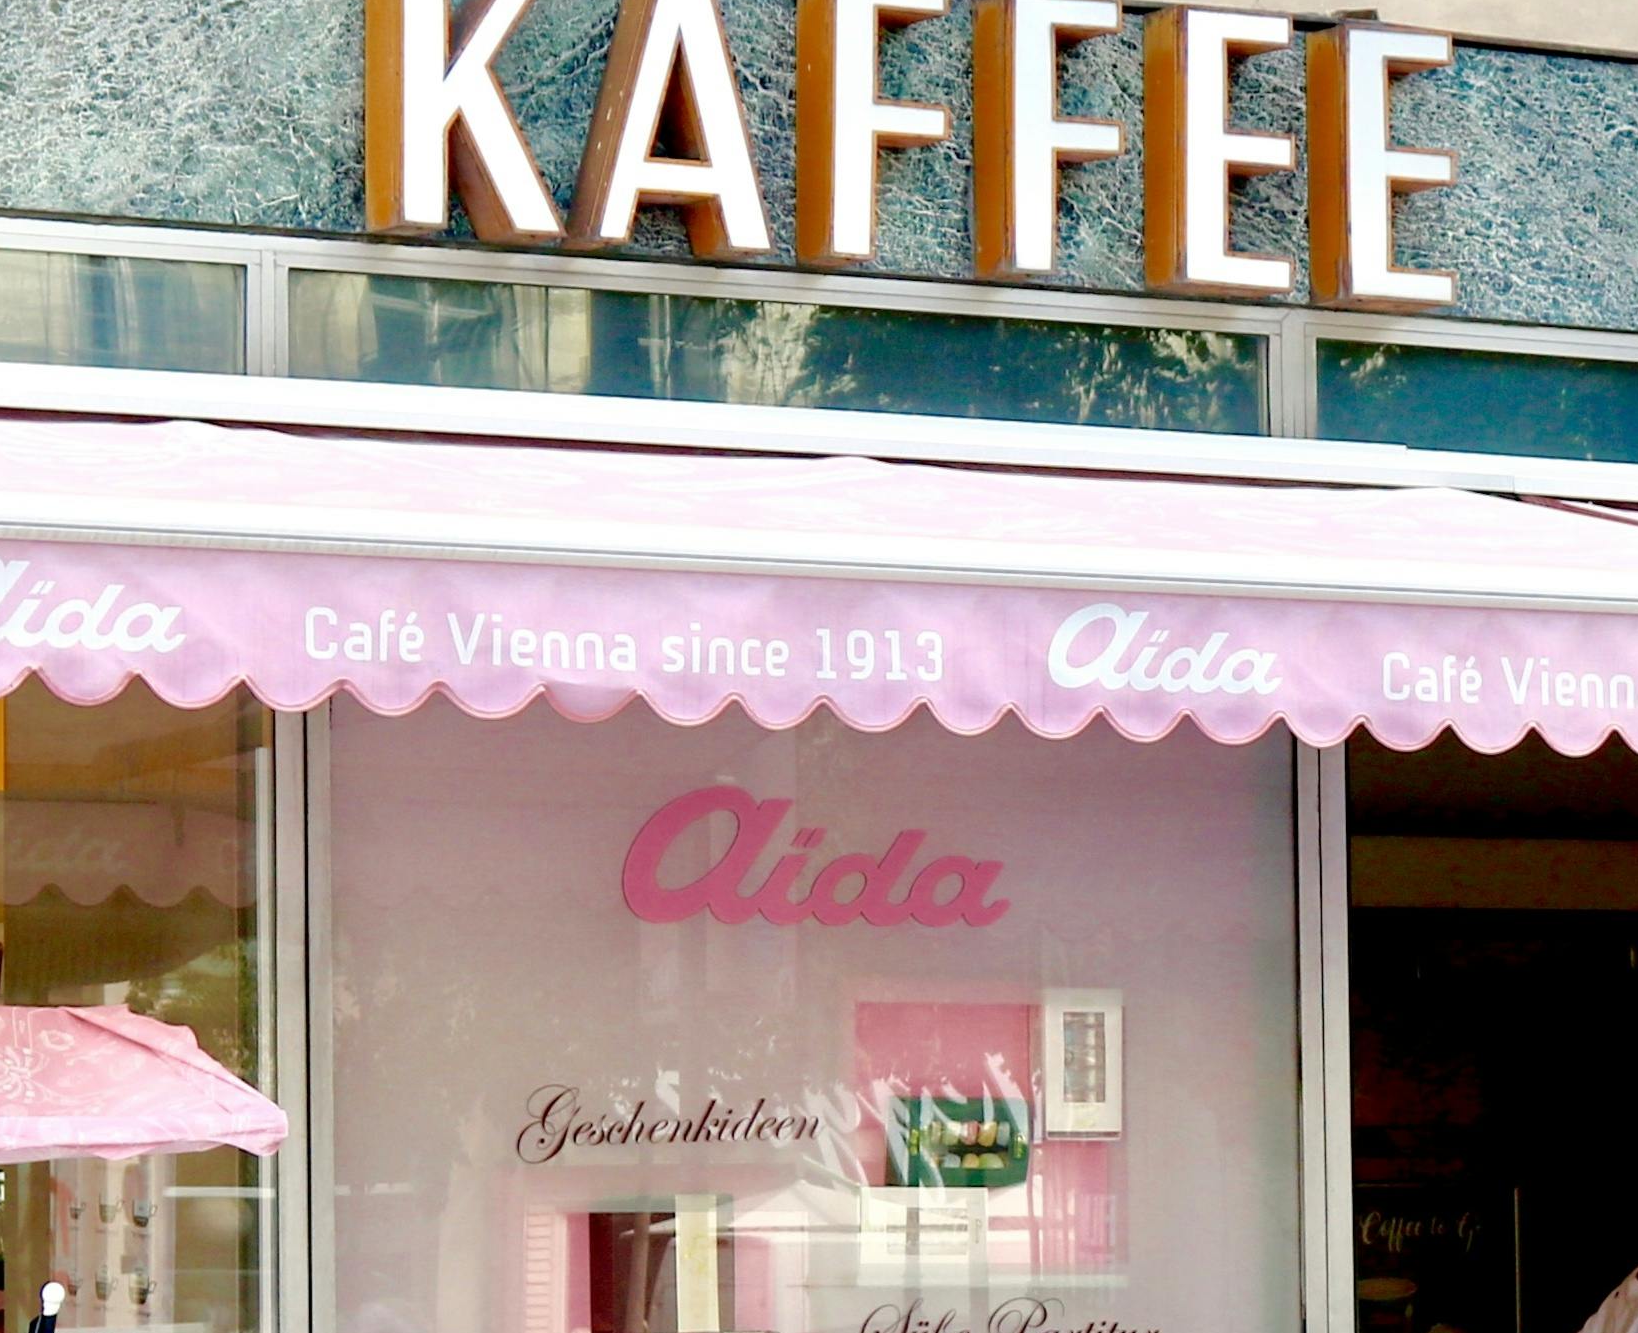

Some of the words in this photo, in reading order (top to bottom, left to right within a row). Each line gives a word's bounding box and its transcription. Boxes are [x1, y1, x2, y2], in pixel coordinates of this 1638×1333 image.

[304, 606, 425, 663] Café
[447, 612, 637, 672] Vienna
[661, 622, 790, 677] since
[816, 628, 943, 682] 1913
[1383, 651, 1483, 704] Café
[515, 1083, 821, 1165] Geschenkideen
